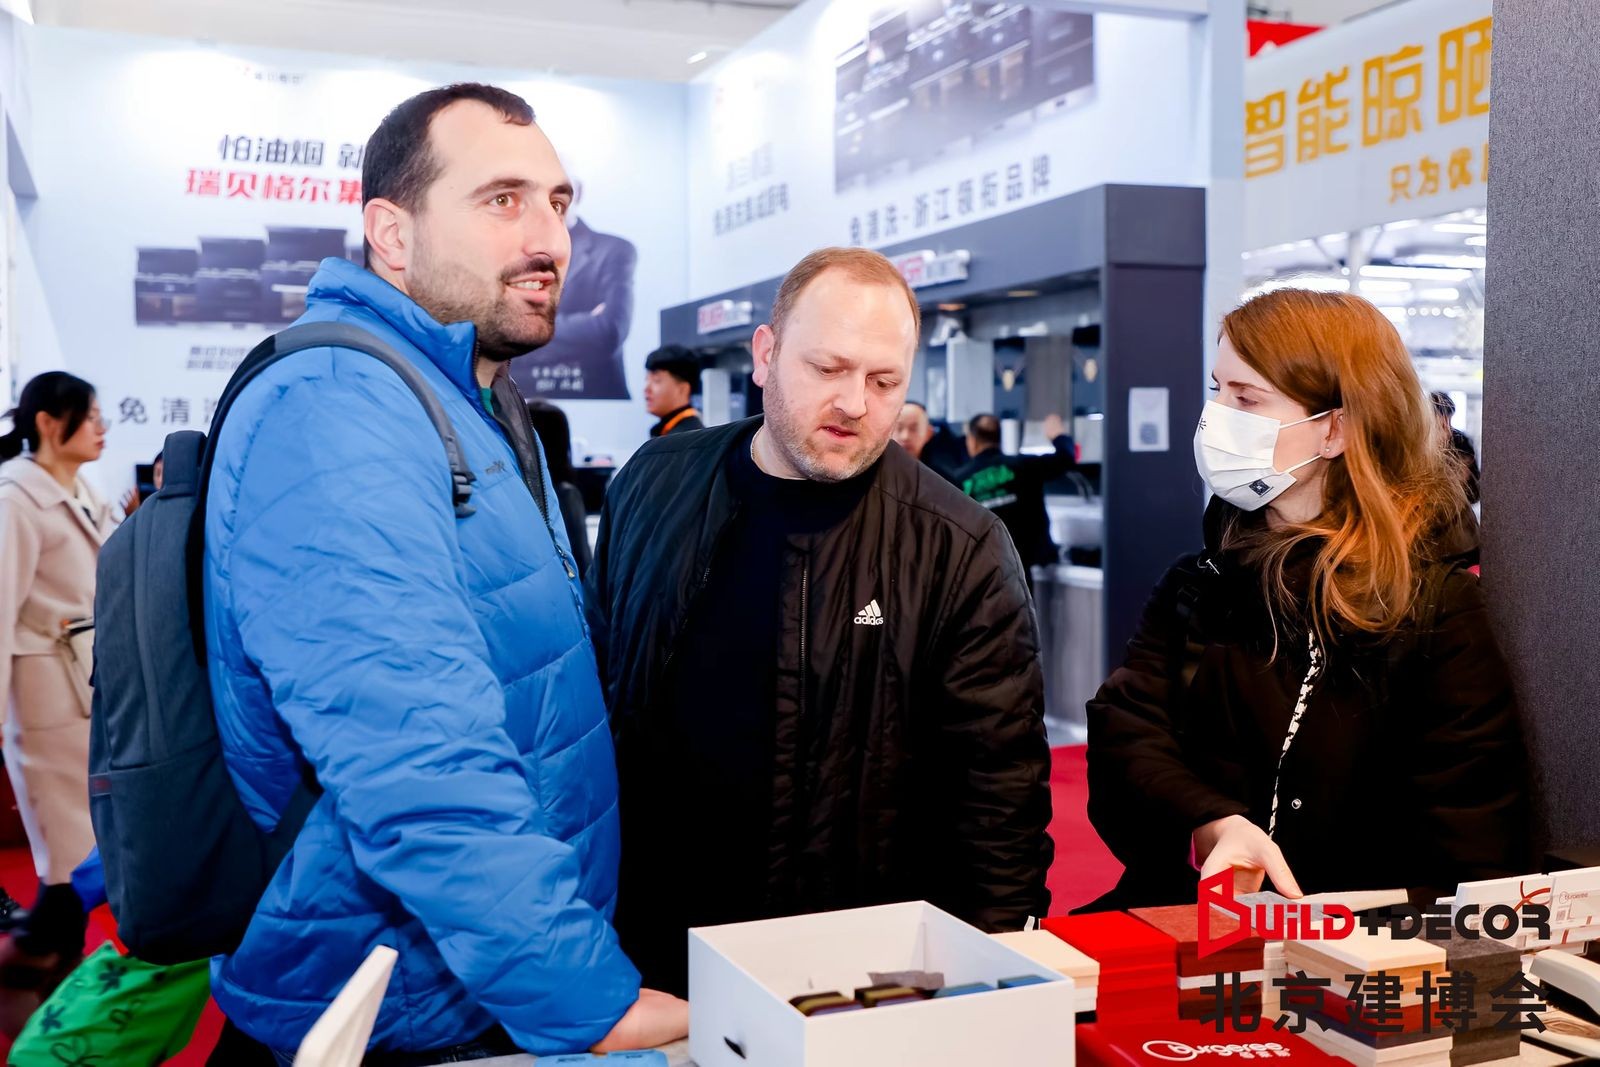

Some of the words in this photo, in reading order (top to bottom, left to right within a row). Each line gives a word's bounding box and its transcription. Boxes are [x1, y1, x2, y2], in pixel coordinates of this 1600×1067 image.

[219, 134, 324, 166] 怕油烟
[1390, 143, 1488, 204] 只为优
[853, 615, 884, 626] adidas
